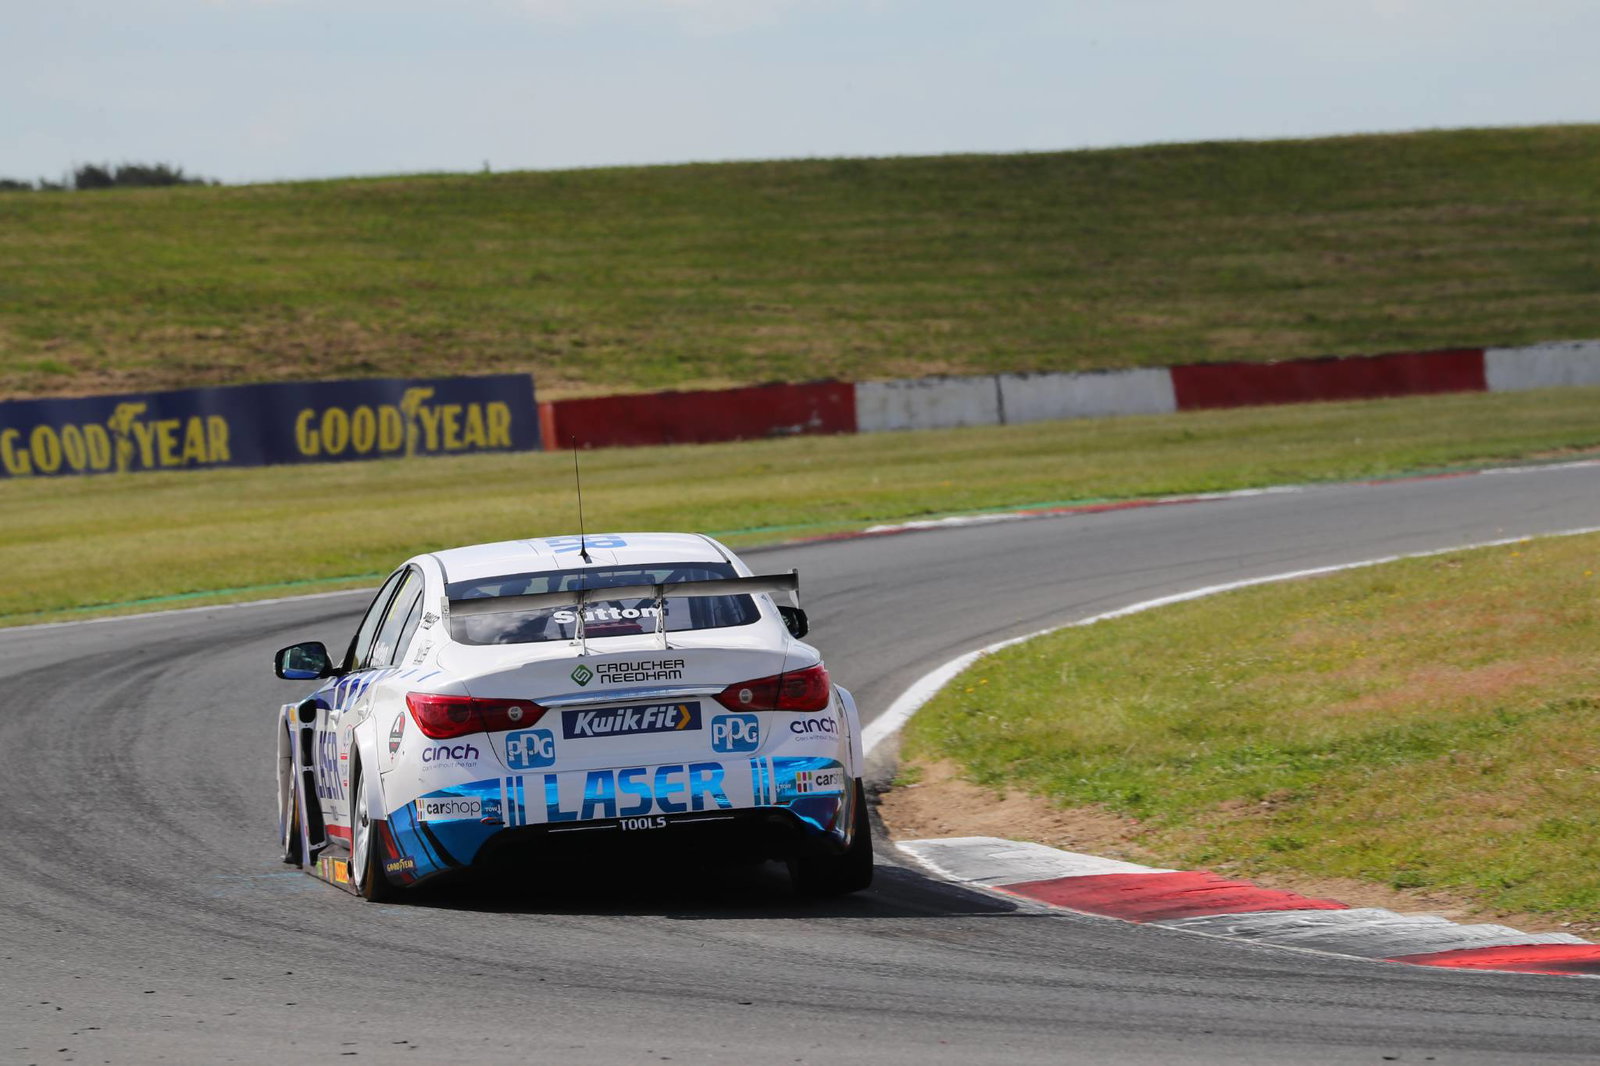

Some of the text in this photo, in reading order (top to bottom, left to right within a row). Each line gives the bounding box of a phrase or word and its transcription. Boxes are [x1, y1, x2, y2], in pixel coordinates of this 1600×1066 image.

[295, 401, 513, 455] GOODYEAR
[0, 415, 231, 474] GOODYEAR
[553, 607, 661, 624] Sutton
[596, 659, 685, 675] CROUCHER
[600, 669, 682, 684] NEEDHAM
[713, 716, 758, 750] PPG
[790, 717, 838, 735] cinch
[422, 743, 479, 763] cinch
[508, 733, 554, 765] PPG
[545, 762, 731, 822] LASER
[426, 800, 480, 816] carshop
[619, 817, 667, 831] TOOLS
[386, 858, 414, 873] GOODYEAR
